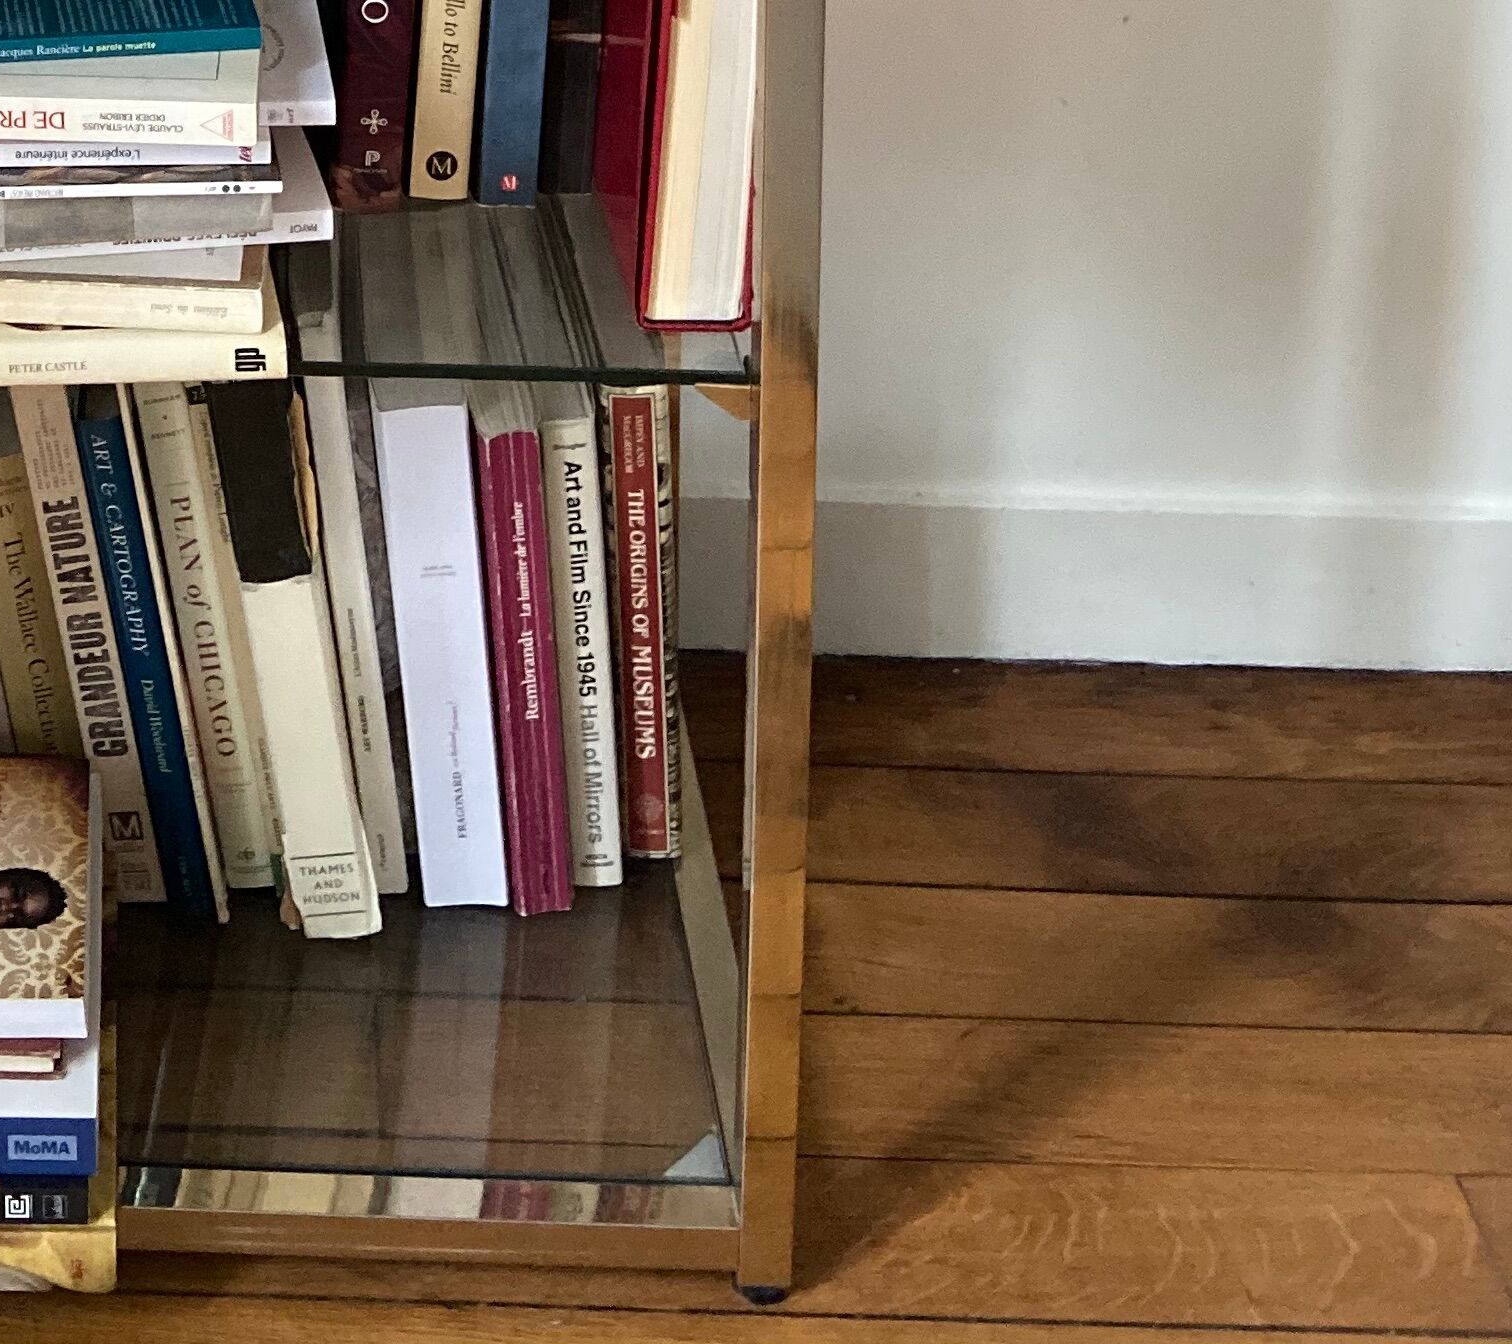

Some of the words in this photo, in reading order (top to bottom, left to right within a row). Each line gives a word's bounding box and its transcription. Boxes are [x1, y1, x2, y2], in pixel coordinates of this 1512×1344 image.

[442, 21, 461, 37] to
[438, 42, 461, 95] Bellini
[32, 110, 65, 129] DE
[81, 122, 144, 133] LÉVI-STRAUSS
[146, 123, 183, 132] CLAUDE
[8, 362, 42, 374] PETER
[44, 360, 88, 372] CASTLE
[89, 431, 113, 475] ART
[99, 480, 118, 498] &
[565, 460, 586, 493] Art
[567, 494, 589, 535] and
[629, 488, 649, 527] THE
[42, 495, 98, 606] NATURE
[169, 494, 203, 573] PLAN
[104, 503, 150, 657] CARTOGRAPHY
[570, 538, 592, 582] Film
[629, 529, 651, 609] ORIGINS
[180, 581, 211, 613] of
[573, 588, 596, 645] Since
[633, 613, 652, 638] OF
[65, 609, 128, 761] GRANDEUR
[191, 618, 236, 758] CHICAGO
[577, 649, 599, 697] 1945
[580, 702, 600, 742] Hall
[632, 643, 658, 761] MUSEUMS
[583, 745, 602, 769] of
[584, 771, 607, 844] Mirrors
[13, 1139, 71, 1158] MoMA
